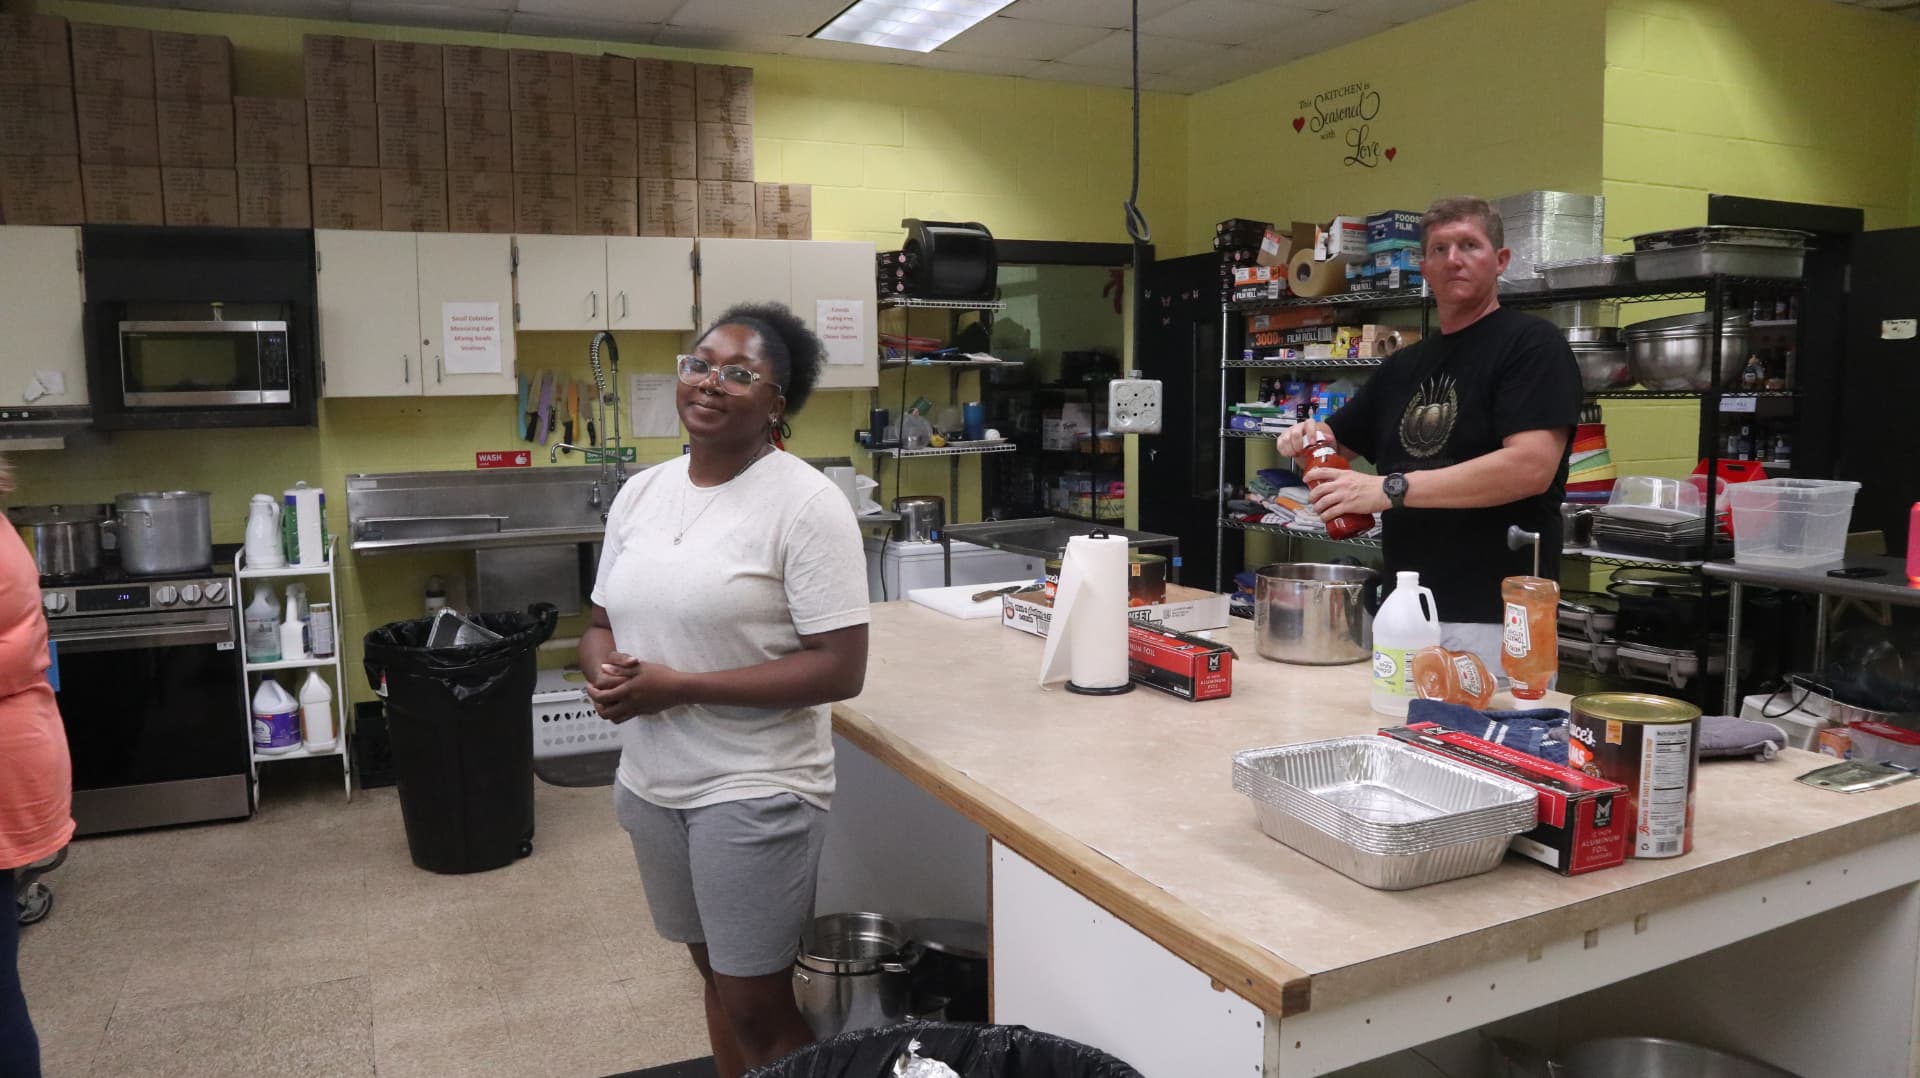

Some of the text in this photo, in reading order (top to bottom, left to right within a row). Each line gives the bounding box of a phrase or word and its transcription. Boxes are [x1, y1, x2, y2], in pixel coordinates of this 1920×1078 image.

[1298, 98, 1313, 110] This
[1323, 81, 1362, 102] KITCHEN
[1310, 91, 1381, 133] Seasoned
[1320, 129, 1336, 141] with
[1343, 123, 1381, 168] Love
[1394, 213, 1422, 224] FOODS
[1394, 221, 1413, 231] FILM
[1286, 333, 1302, 344] FILM
[1302, 332, 1318, 342] ROLL
[479, 453, 502, 463] WASH
[1143, 646, 1156, 657] FOIL
[1491, 747, 1554, 771] ALUMINUM
[1581, 834, 1621, 848] ALUMINUM
[1591, 846, 1608, 854] FOIL
